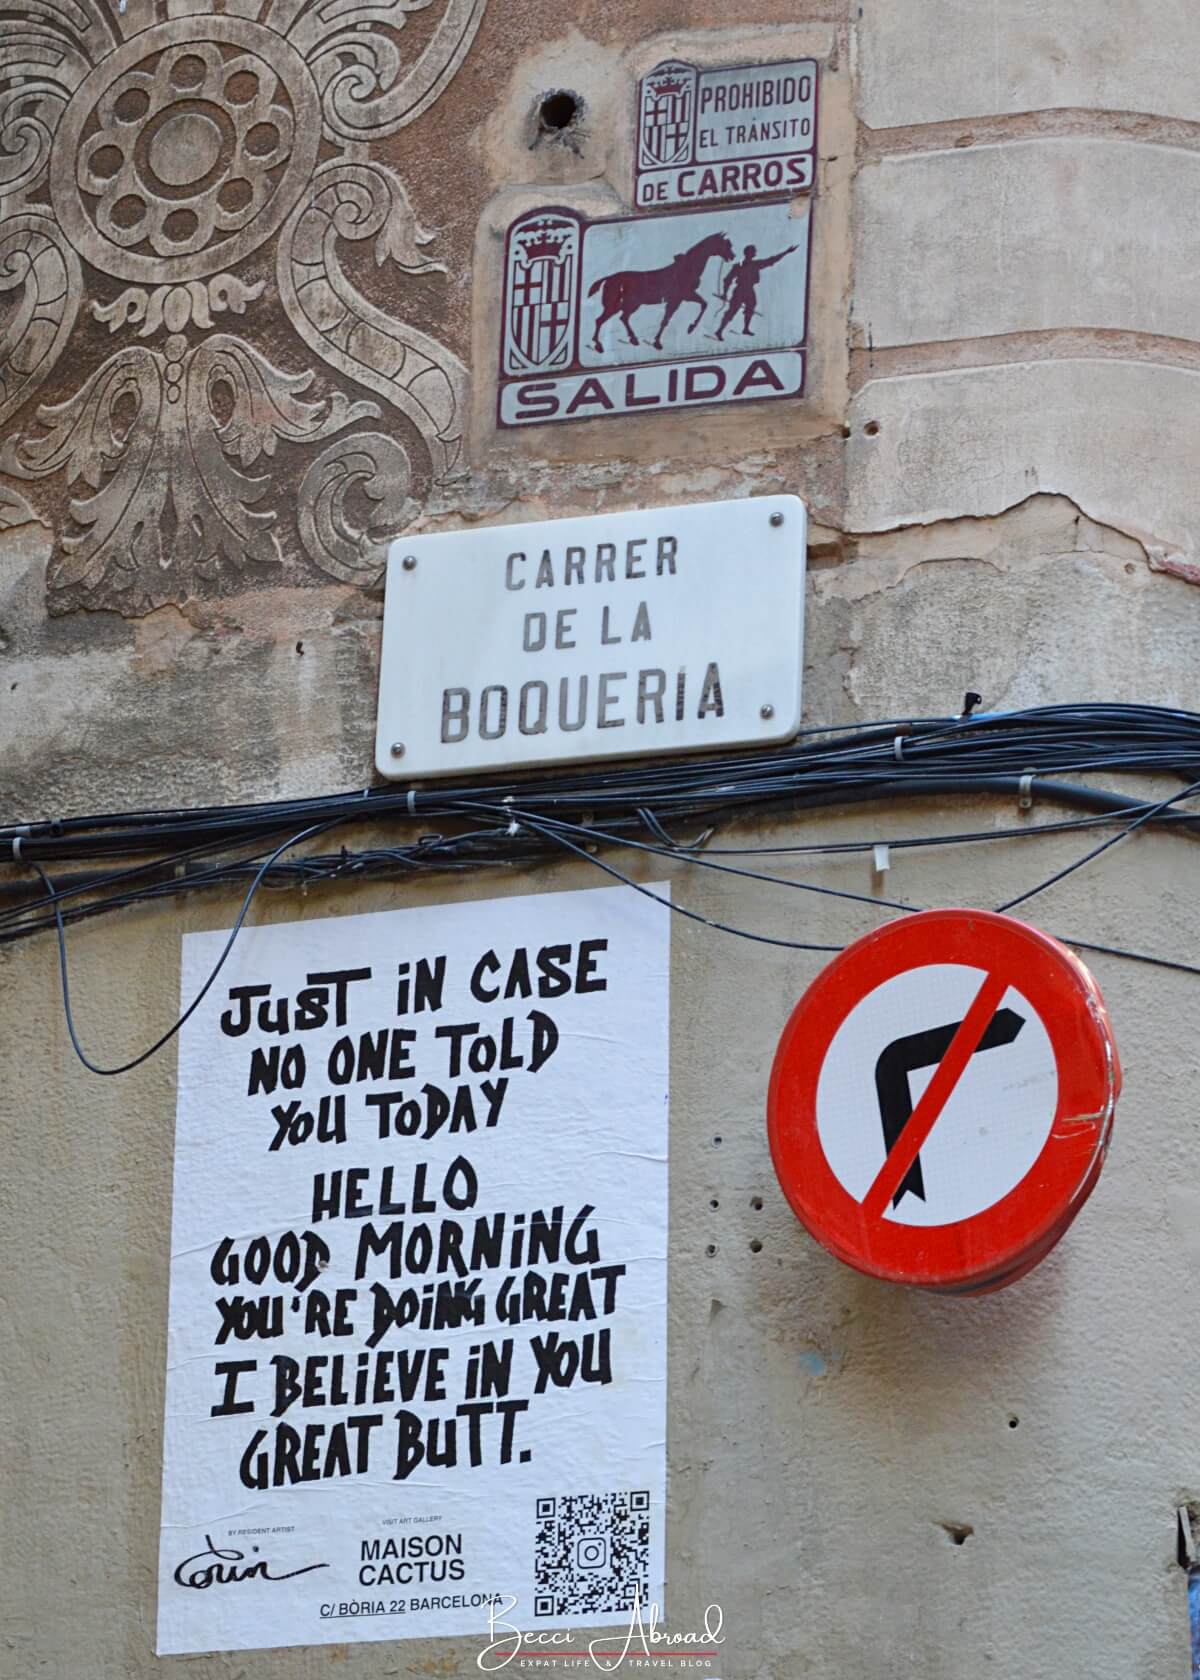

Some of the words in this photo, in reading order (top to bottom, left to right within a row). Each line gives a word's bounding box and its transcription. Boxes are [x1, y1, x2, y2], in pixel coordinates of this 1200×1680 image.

[700, 75, 811, 114] PROHIBIDO
[699, 129, 718, 148] EL
[643, 182, 668, 201] DE
[677, 157, 807, 197] CARROS
[515, 359, 786, 420] SALIDA
[505, 535, 679, 591] CARRER
[522, 608, 577, 652] DE
[600, 600, 652, 645] LA
[440, 662, 725, 744] BOQUERIA
[470, 938, 608, 1003] CASE
[247, 1043, 306, 1096] NO
[327, 1027, 417, 1085] ONE
[311, 1155, 479, 1224] HELLO
[210, 1229, 331, 1291] GOOD
[496, 1264, 627, 1325] GREAT
[210, 1359, 258, 1418] I
[529, 1328, 612, 1395] YOU
[239, 1414, 383, 1491] GREAT
[227, 1529, 237, 1537] BY
[237, 1527, 270, 1536] RESIDENT
[272, 1525, 296, 1533] ARTIST
[360, 1533, 463, 1562] MAISON
[412, 1515, 443, 1524] GALLERY
[358, 1558, 466, 1587] CACTUS
[319, 1602, 335, 1618] C/
[338, 1598, 385, 1616] BÒRIA
[389, 1600, 406, 1614] 22
[409, 1592, 504, 1612] BARCELONA
